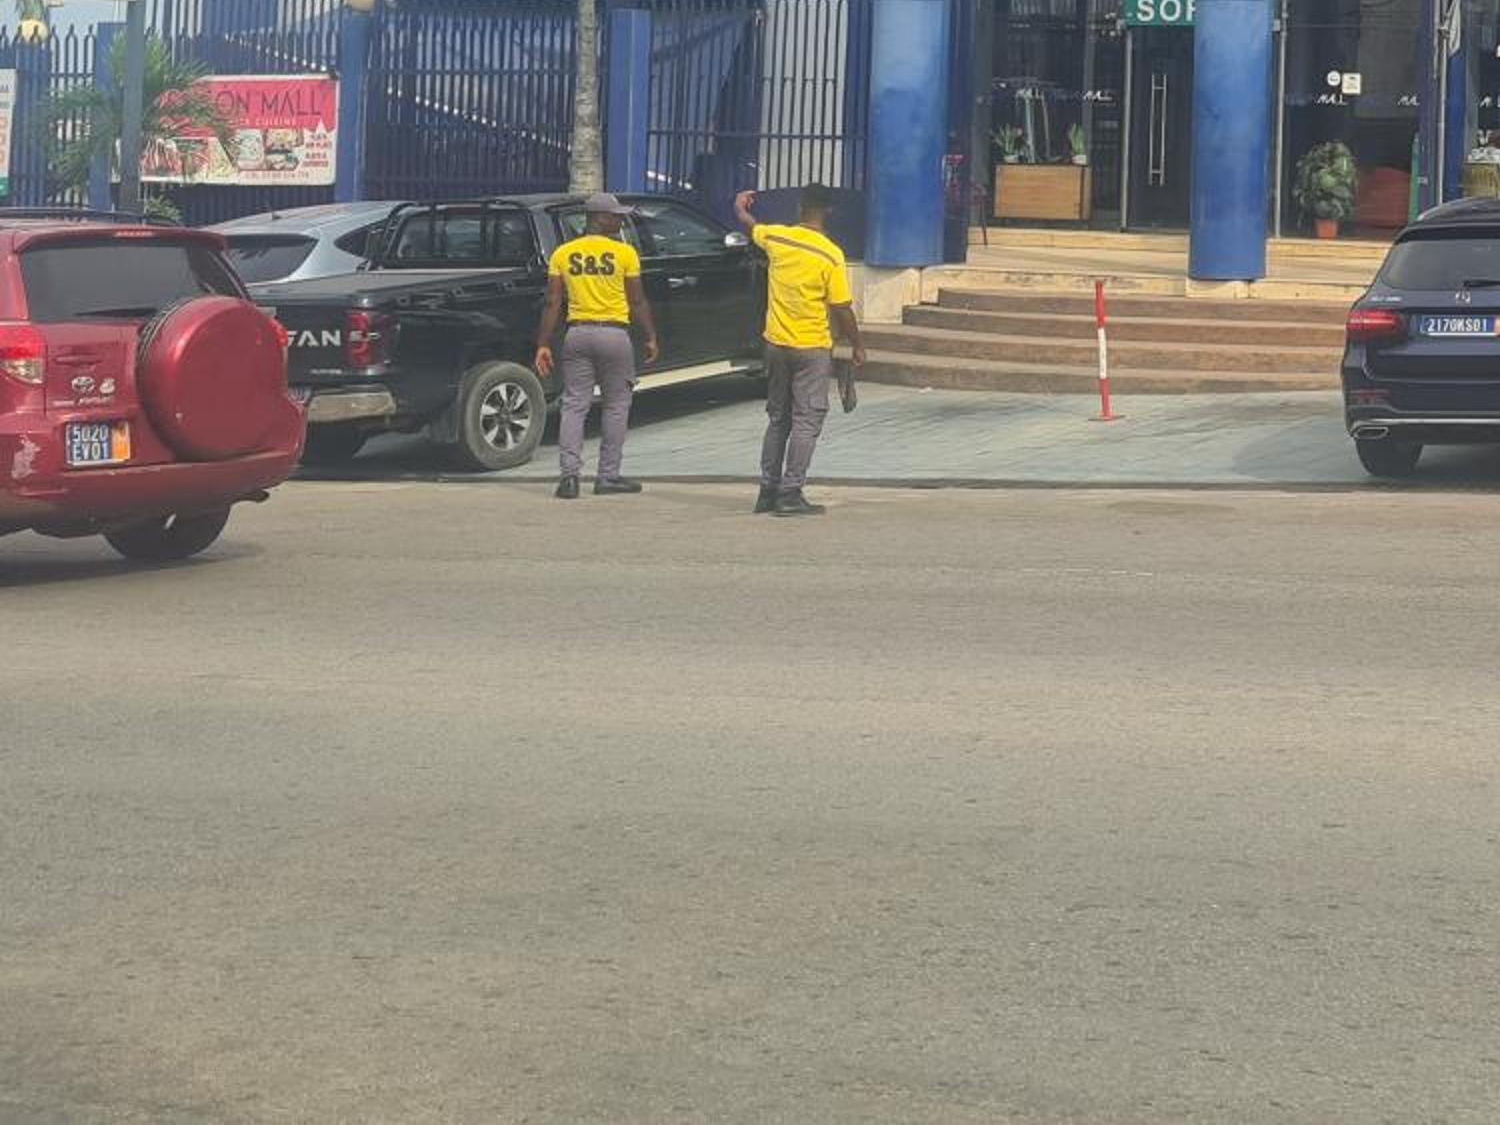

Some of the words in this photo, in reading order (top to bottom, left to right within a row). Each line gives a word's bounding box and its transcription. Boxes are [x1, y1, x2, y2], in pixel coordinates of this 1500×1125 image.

[260, 90, 322, 117] MALL
[568, 251, 615, 276] S&S
[71, 424, 109, 442] 5020
